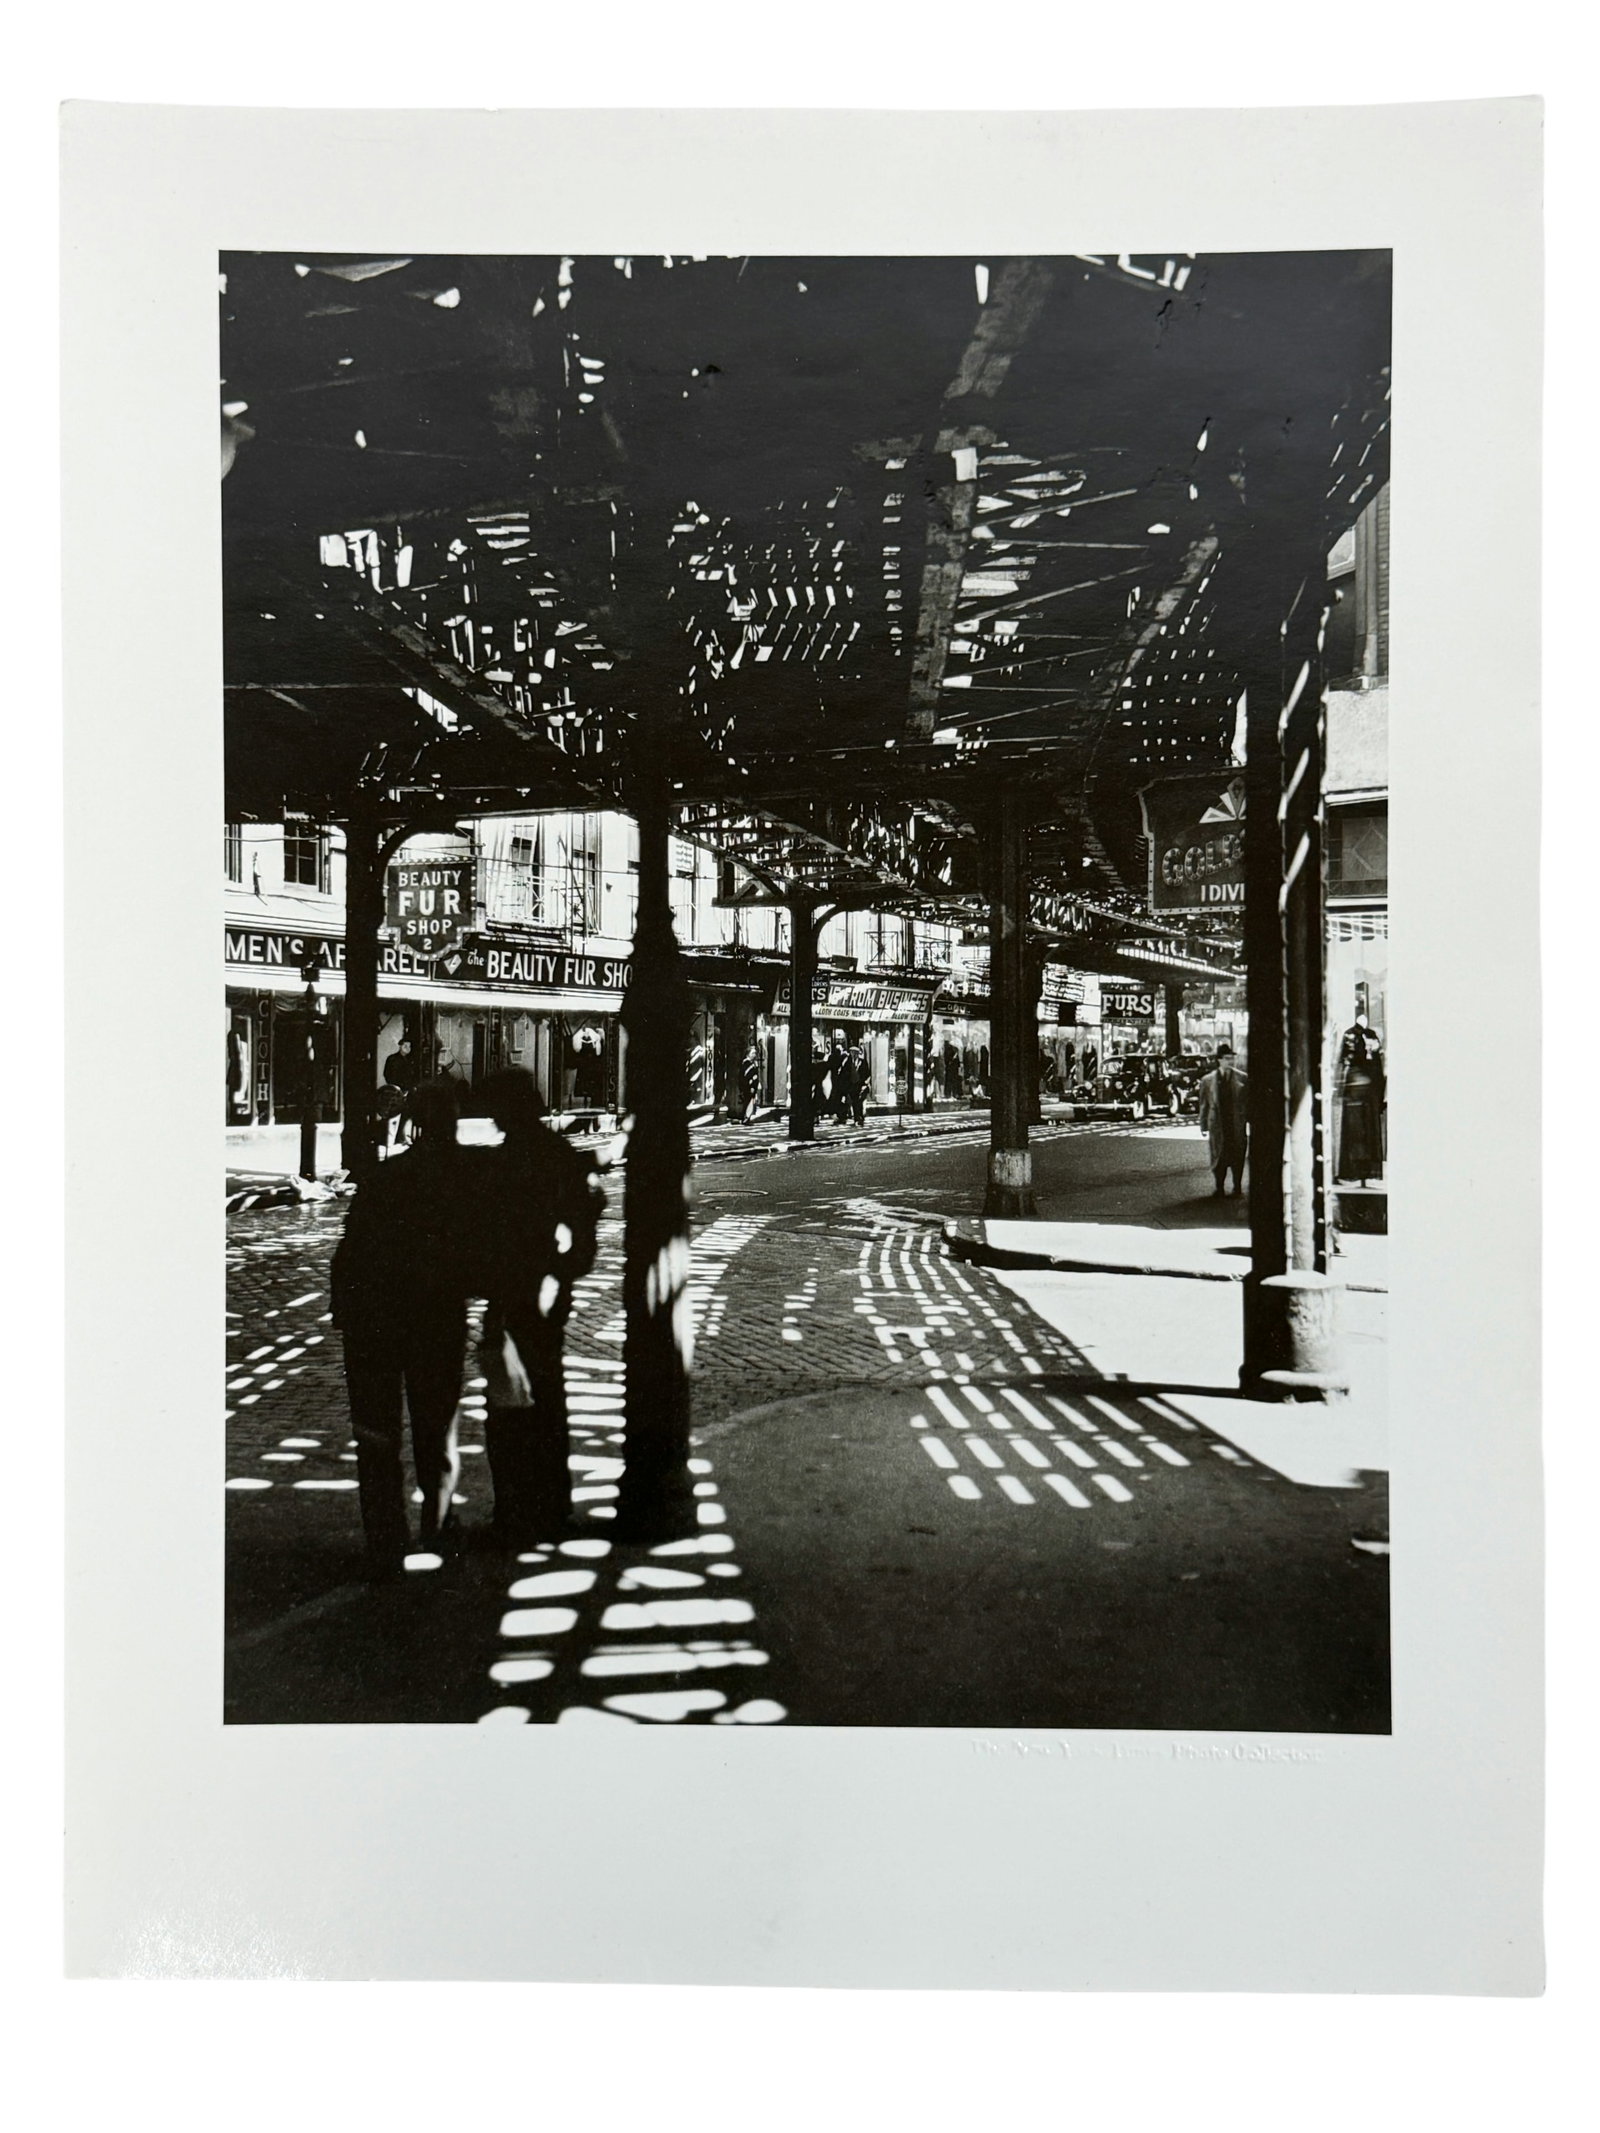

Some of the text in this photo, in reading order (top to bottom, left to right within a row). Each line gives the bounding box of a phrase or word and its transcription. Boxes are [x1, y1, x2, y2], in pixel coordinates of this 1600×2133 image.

[398, 870, 462, 888] BEAUTY
[398, 889, 463, 917] FUR
[406, 918, 453, 936] SHOP
[225, 932, 304, 965] MEN'S
[319, 941, 425, 975] APREL
[423, 938, 432, 951] 2
[467, 948, 484, 967] The
[487, 950, 557, 983] BEAUTY
[564, 958, 596, 986] FUR
[842, 986, 877, 1008] FROM
[1101, 994, 1152, 1015] FURS
